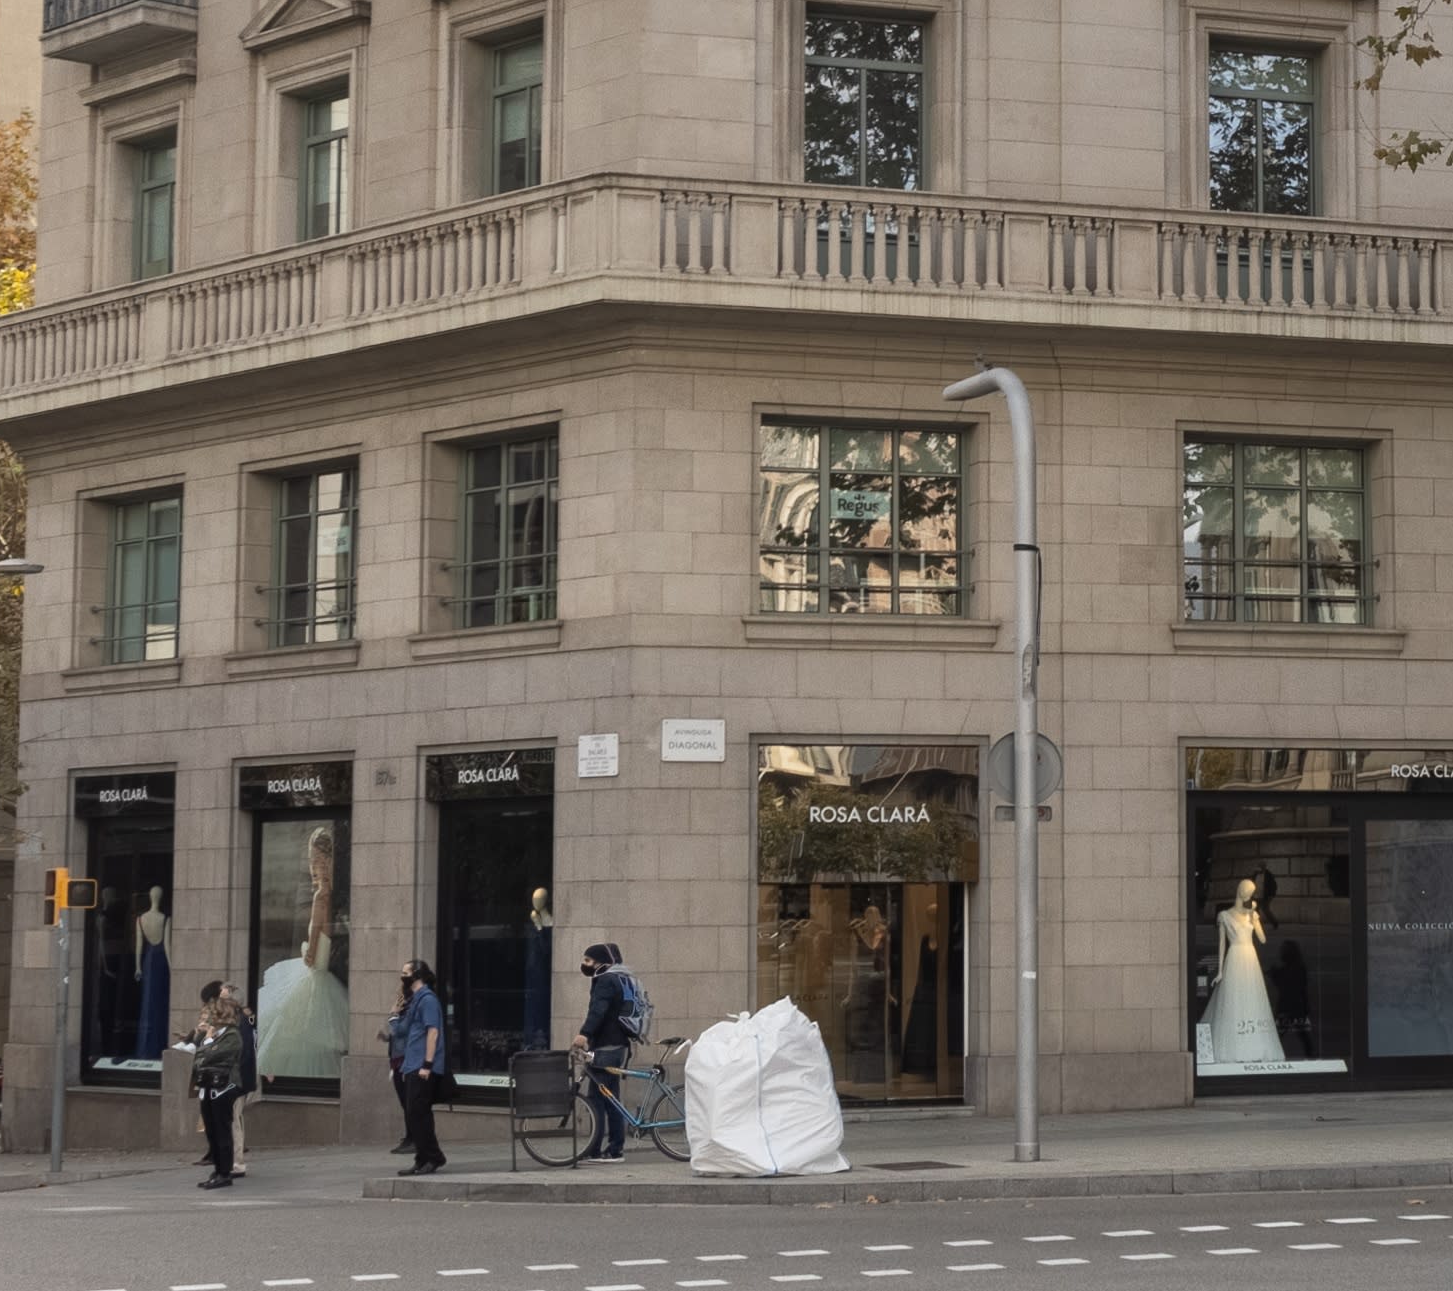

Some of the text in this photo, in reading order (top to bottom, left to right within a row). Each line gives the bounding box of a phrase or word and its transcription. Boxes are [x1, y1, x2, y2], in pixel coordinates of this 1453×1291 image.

[837, 498, 880, 517] Regus
[458, 764, 519, 784] ROSA CLARÁ
[1391, 764, 1430, 778] ROSA
[268, 775, 322, 793] ROSA CLARÁ
[99, 786, 148, 802] ROSA CLARÁ
[809, 803, 930, 823] ROSA CLARÁ
